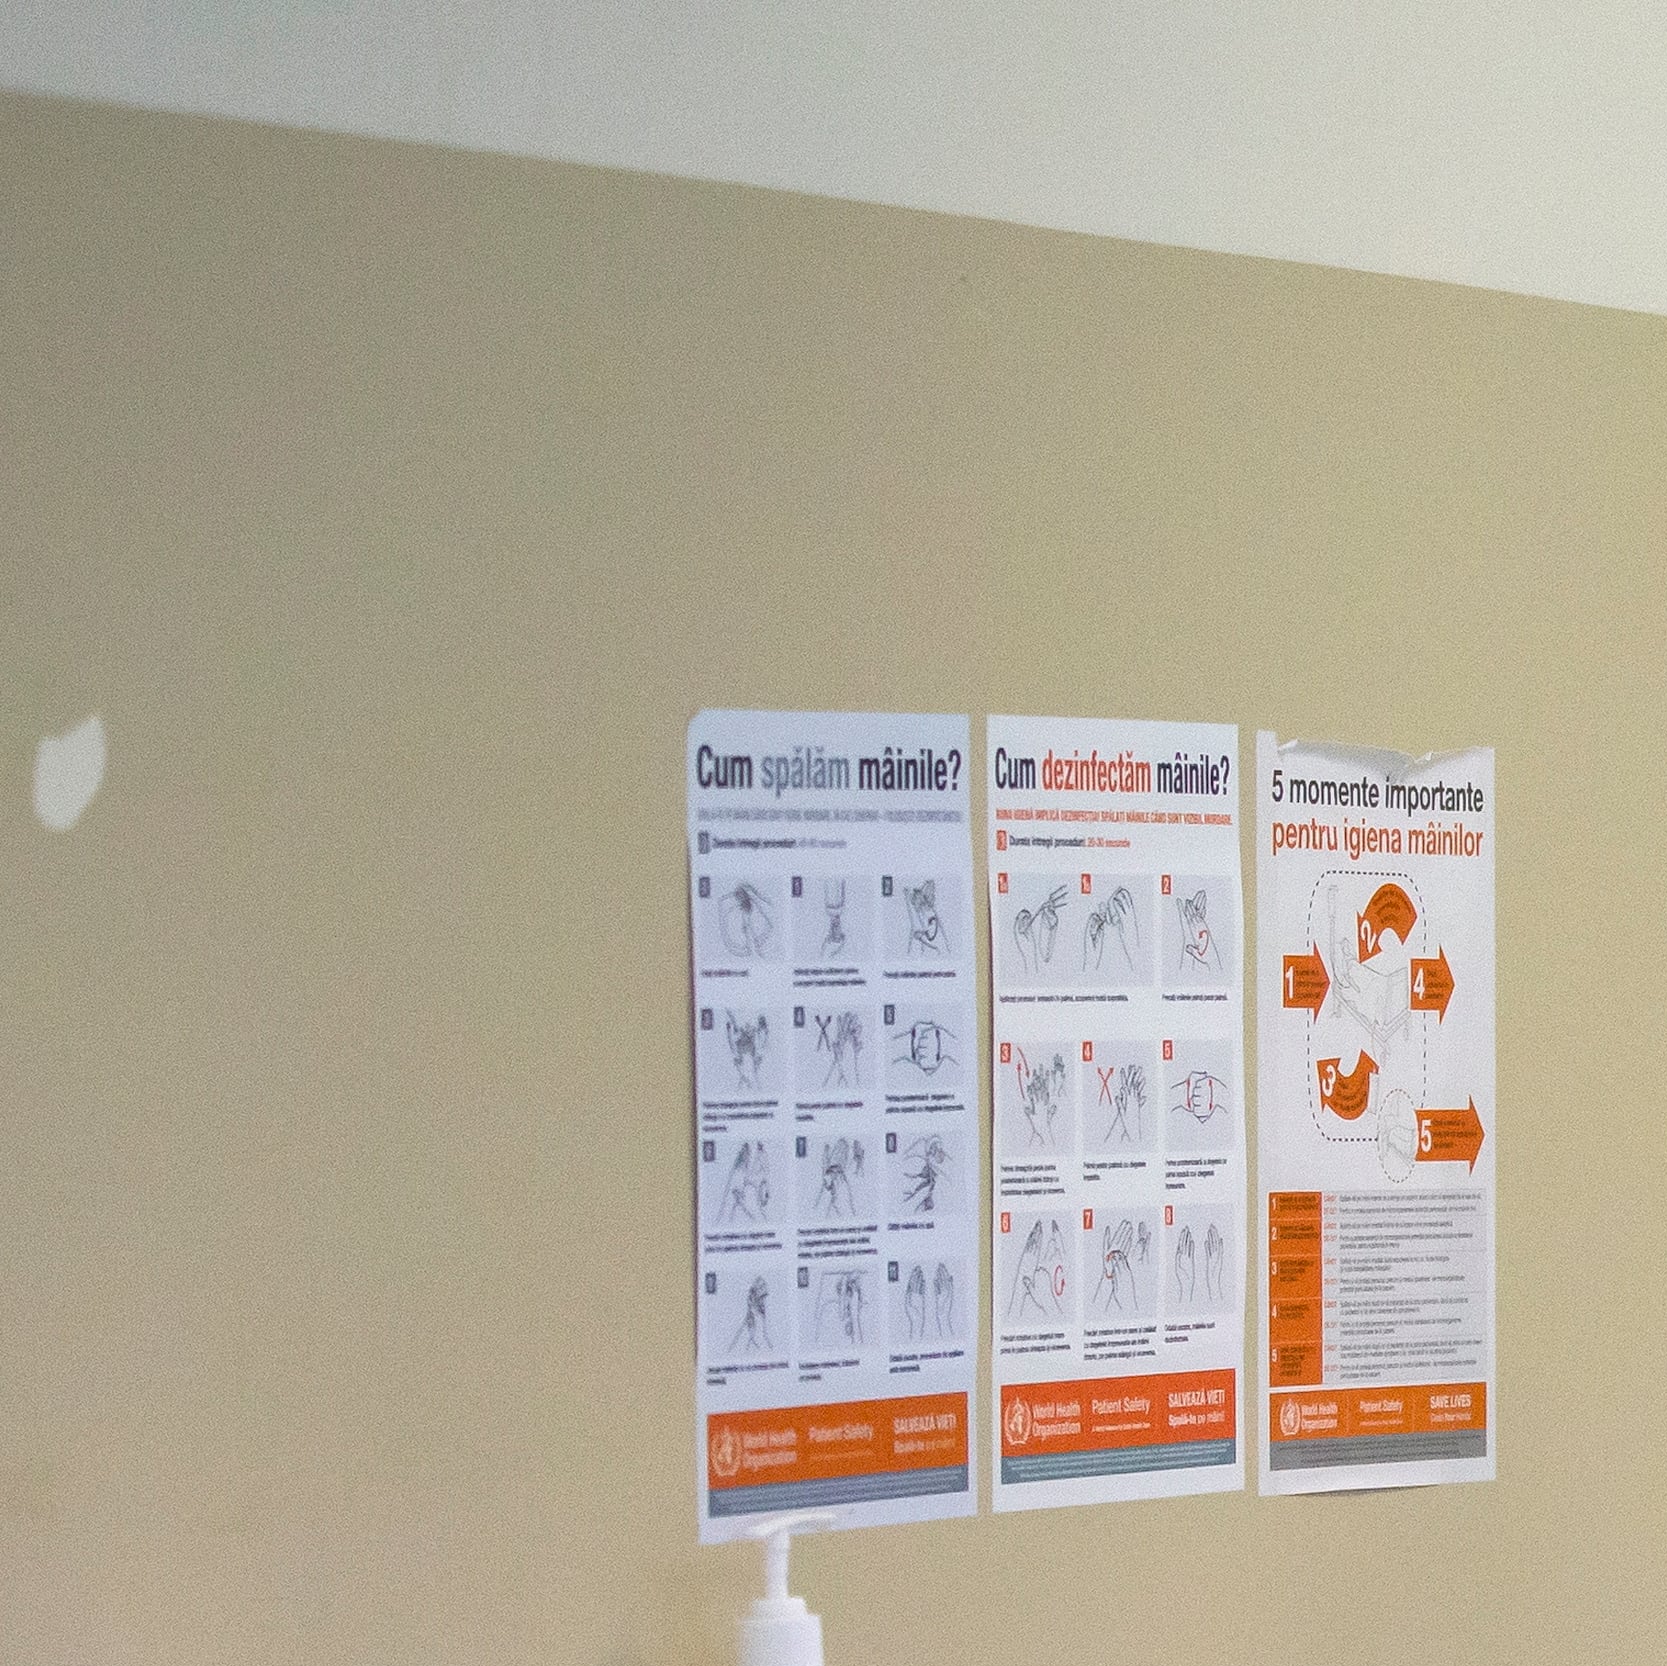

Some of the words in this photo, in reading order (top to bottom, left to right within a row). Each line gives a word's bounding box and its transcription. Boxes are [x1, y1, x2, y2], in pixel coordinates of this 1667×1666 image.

[696, 745, 753, 789] Cum
[761, 746, 849, 798] spălăm
[858, 747, 962, 791] mâinile?
[995, 747, 1036, 790] Cum
[1042, 748, 1151, 793] dezinfectăm
[1157, 752, 1230, 796] mâinile?
[1272, 770, 1283, 802] 5
[1289, 776, 1379, 808] momente
[1385, 776, 1484, 817] importante
[1272, 818, 1338, 856] pentru
[1344, 818, 1401, 860] igiena
[1408, 821, 1484, 857] mâinilor
[1360, 920, 1377, 953] 2
[1285, 966, 1295, 999] 1
[1413, 968, 1426, 1000] 4
[1322, 1064, 1337, 1097] 3
[1420, 1119, 1432, 1152] 5
